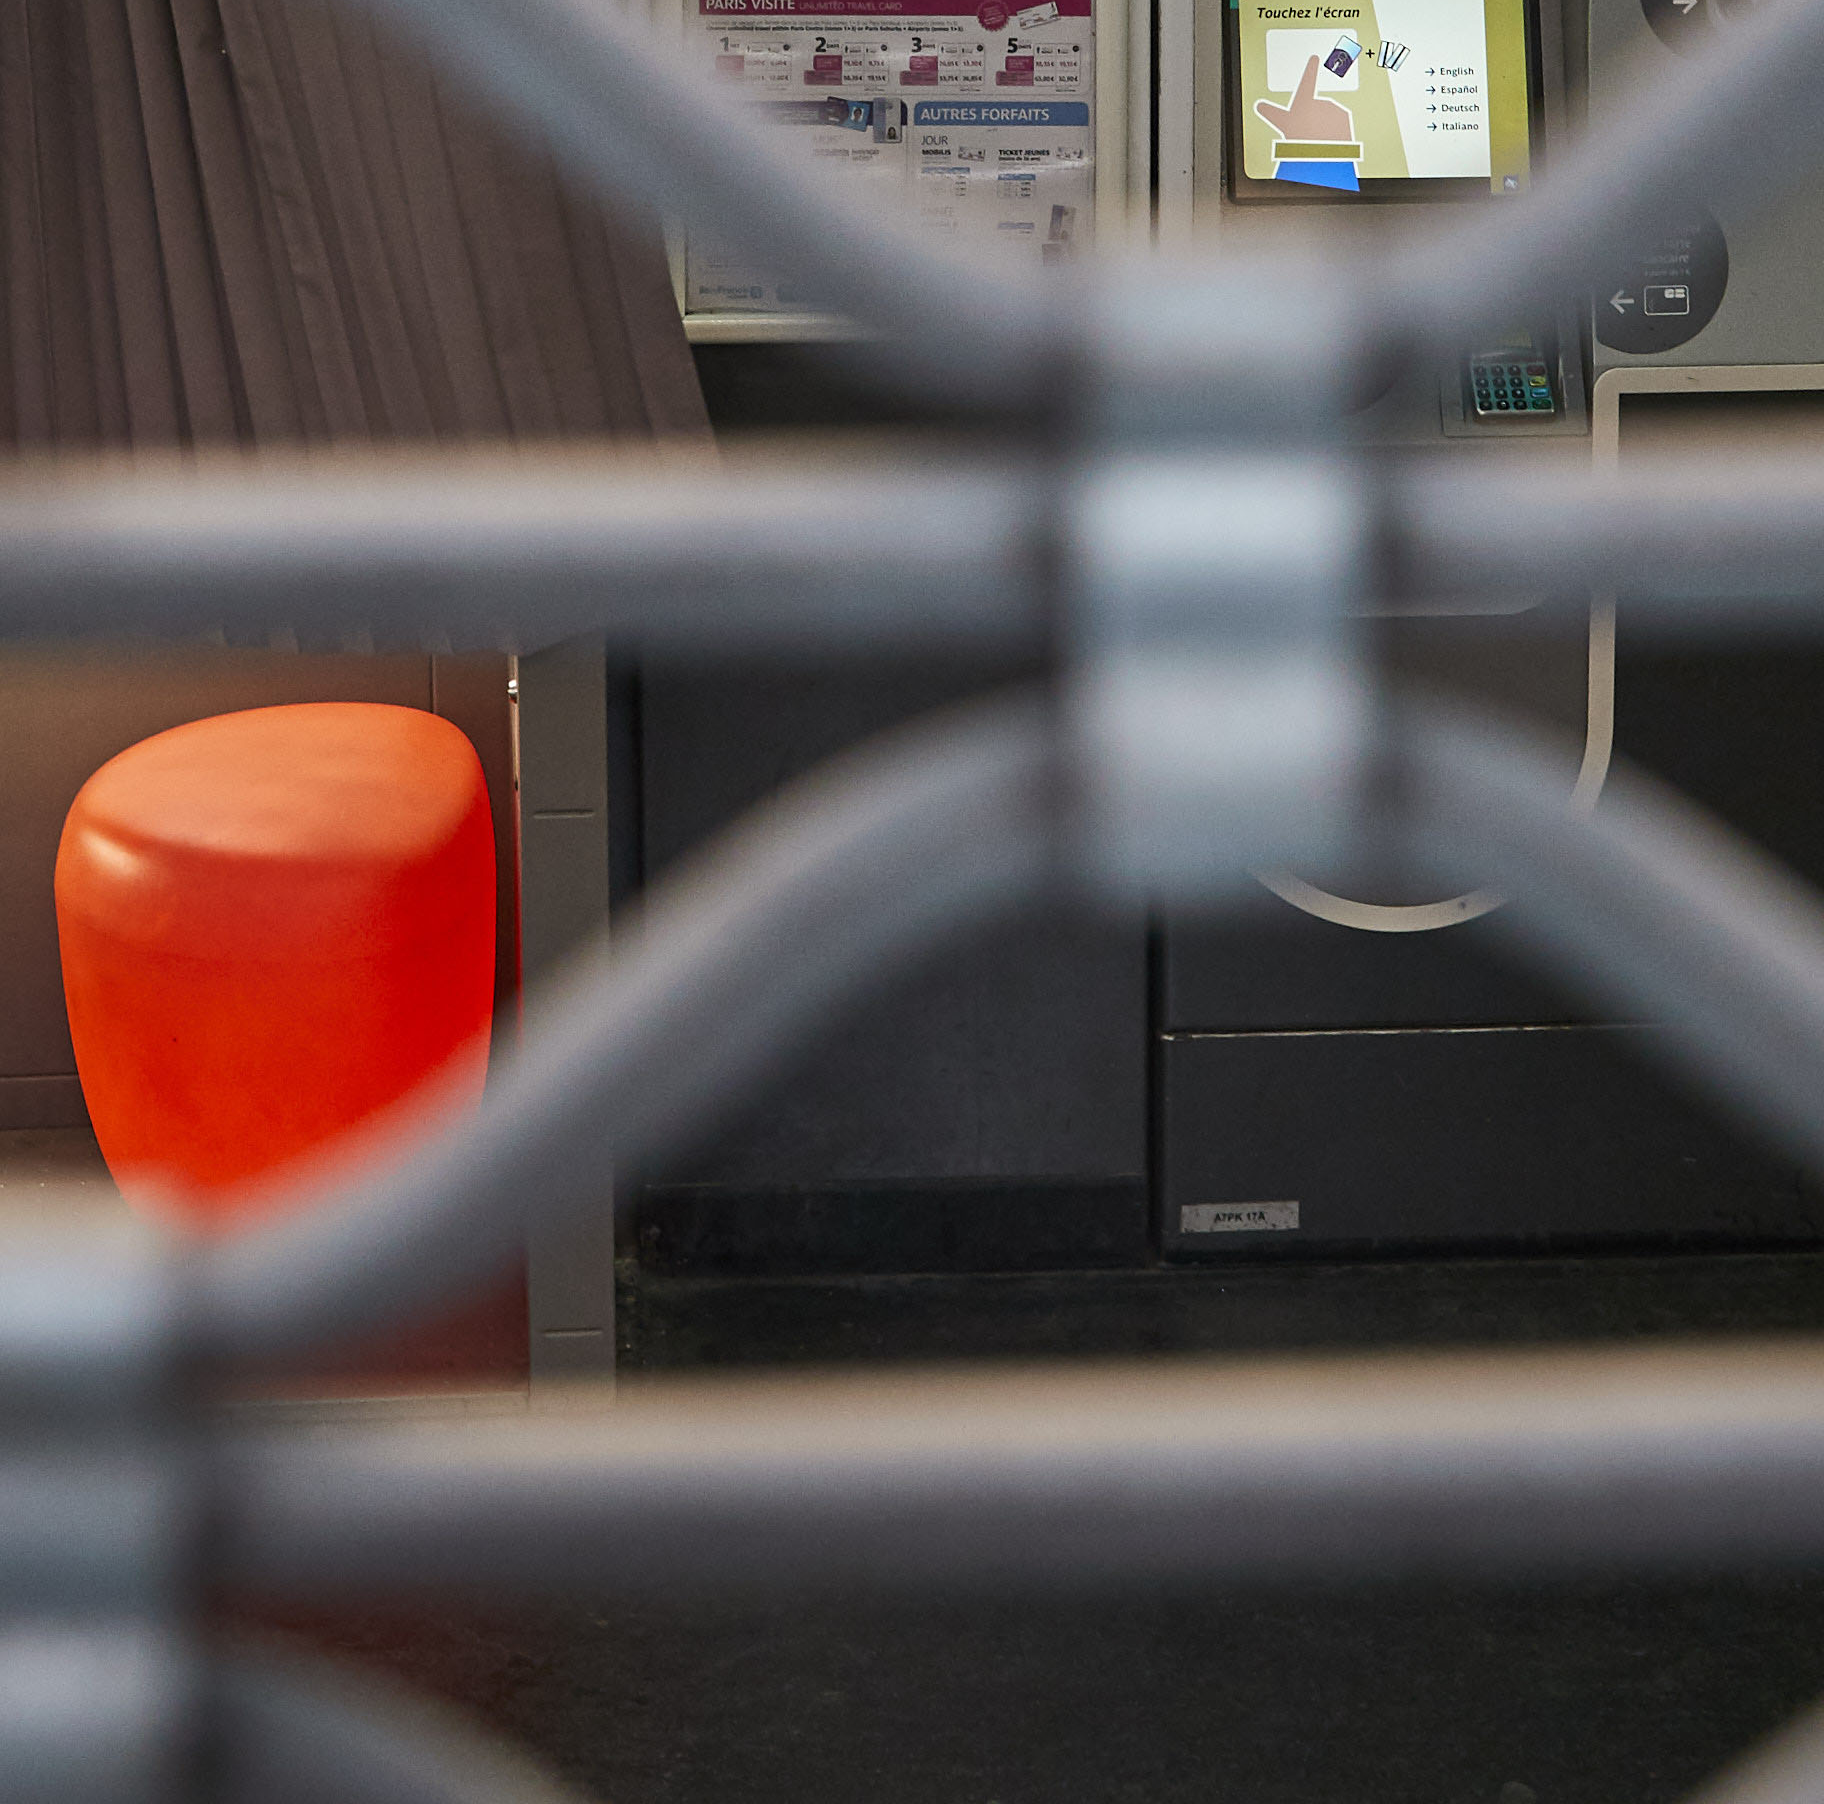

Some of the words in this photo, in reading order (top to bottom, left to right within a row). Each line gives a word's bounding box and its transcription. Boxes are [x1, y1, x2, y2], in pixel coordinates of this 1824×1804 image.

[1257, 7, 1311, 19] Touchez
[1315, 7, 1360, 19] l'écran
[815, 36, 826, 53] 2
[911, 37, 922, 53] 3
[1007, 38, 1018, 54] 5
[1440, 67, 1474, 77] English
[1441, 85, 1478, 95] Español
[1441, 104, 1480, 112] Deutsch
[920, 108, 976, 121] AUTRES
[981, 108, 1050, 121] FORFAITS
[1442, 122, 1479, 130] Italiano
[921, 135, 948, 146] JOUR
